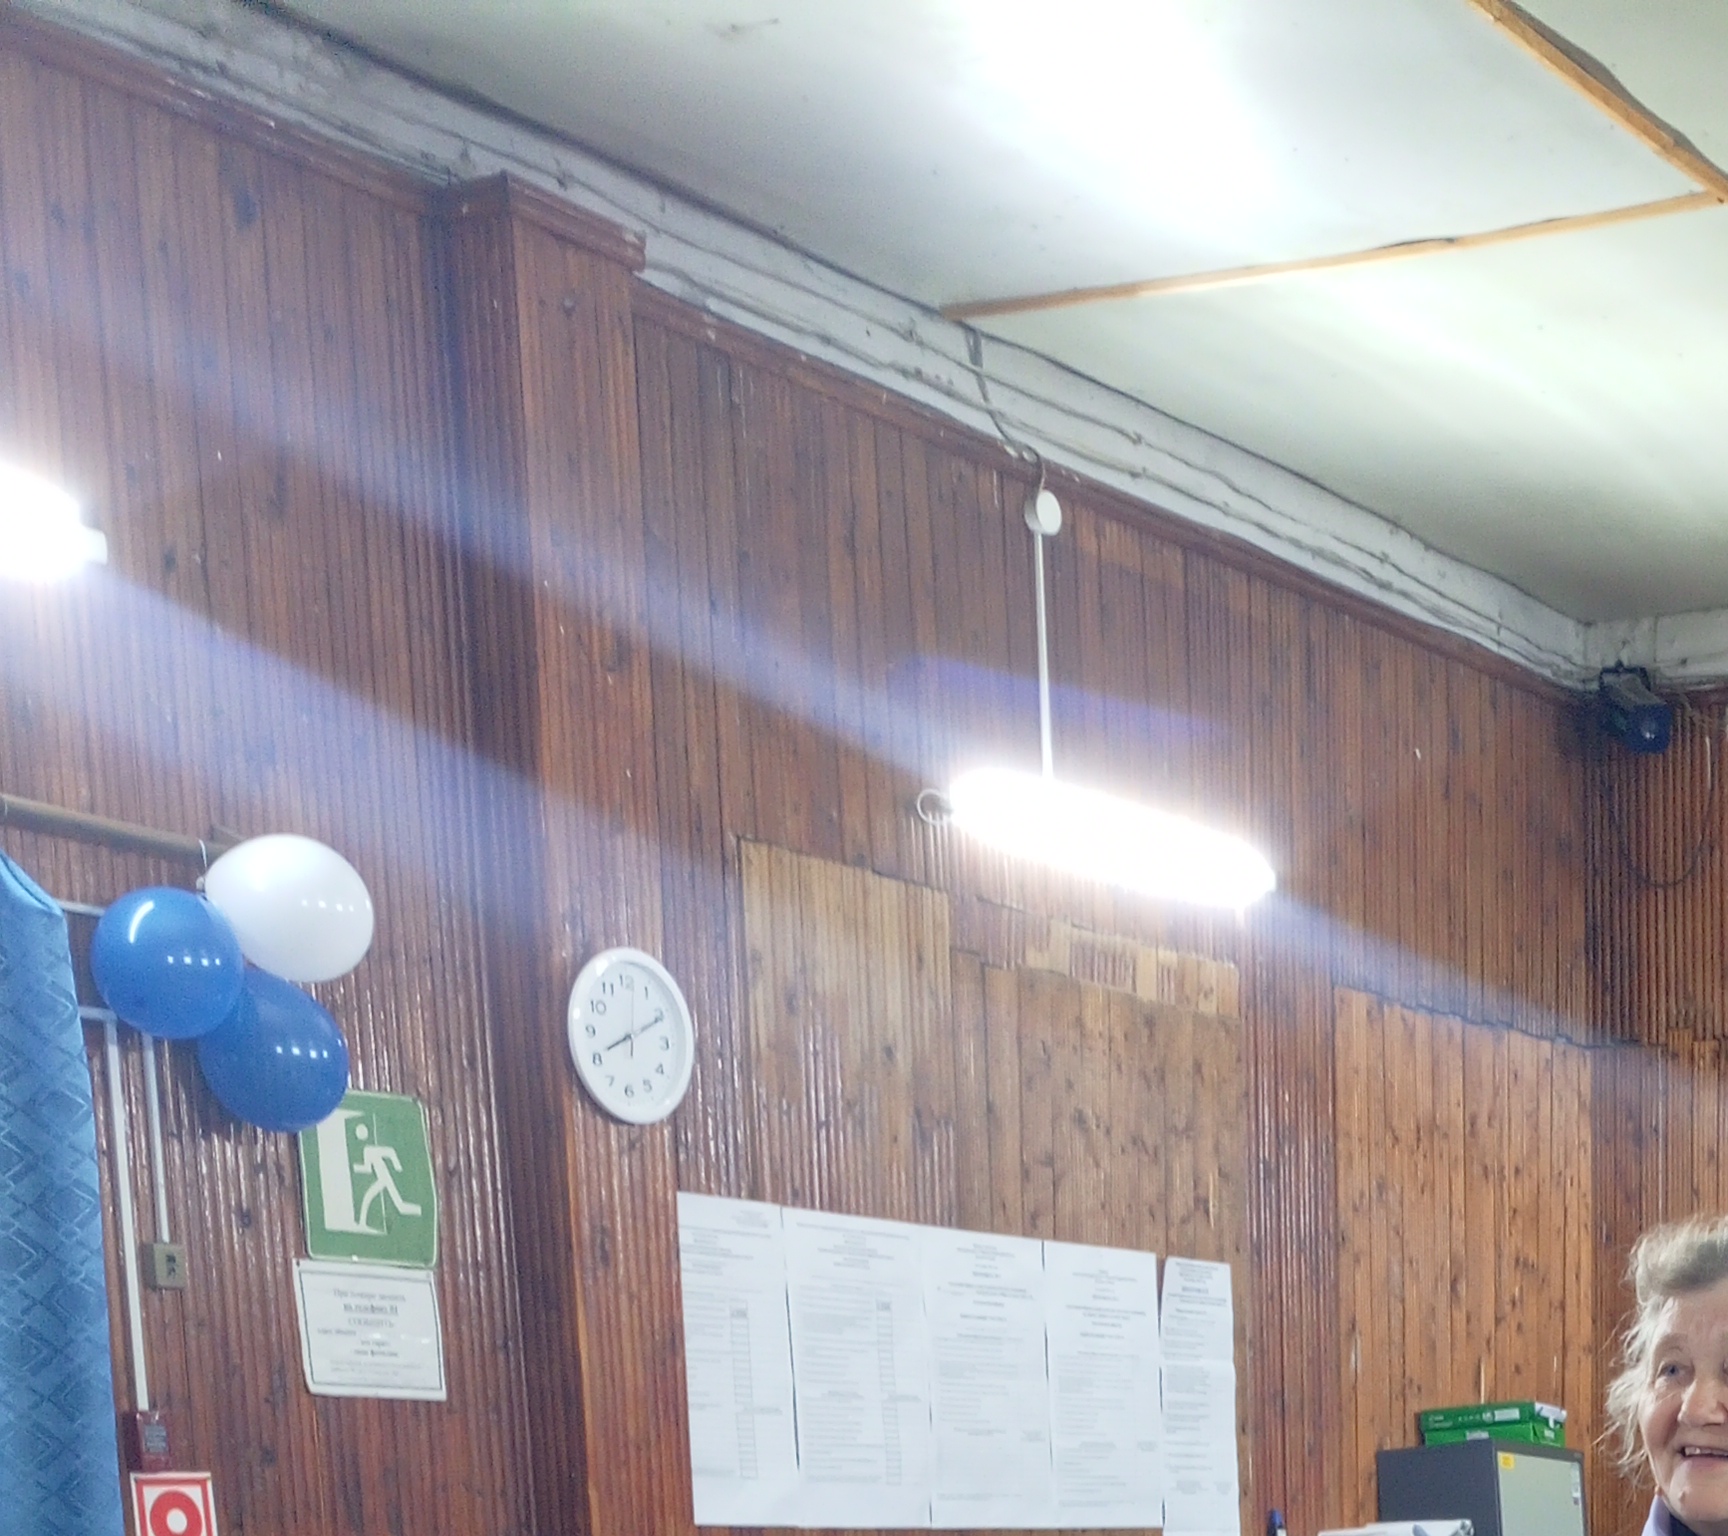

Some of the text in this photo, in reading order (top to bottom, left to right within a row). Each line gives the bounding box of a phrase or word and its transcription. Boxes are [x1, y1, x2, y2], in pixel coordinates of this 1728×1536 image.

[602, 982, 614, 996] 11
[590, 1000, 607, 1014] 10
[585, 1025, 596, 1038] 9
[660, 1036, 670, 1051] 3
[592, 1053, 602, 1066] 8
[655, 1063, 664, 1075] 4
[605, 1075, 615, 1087] 7
[643, 1079, 652, 1093] 5
[625, 1084, 634, 1098] 6
